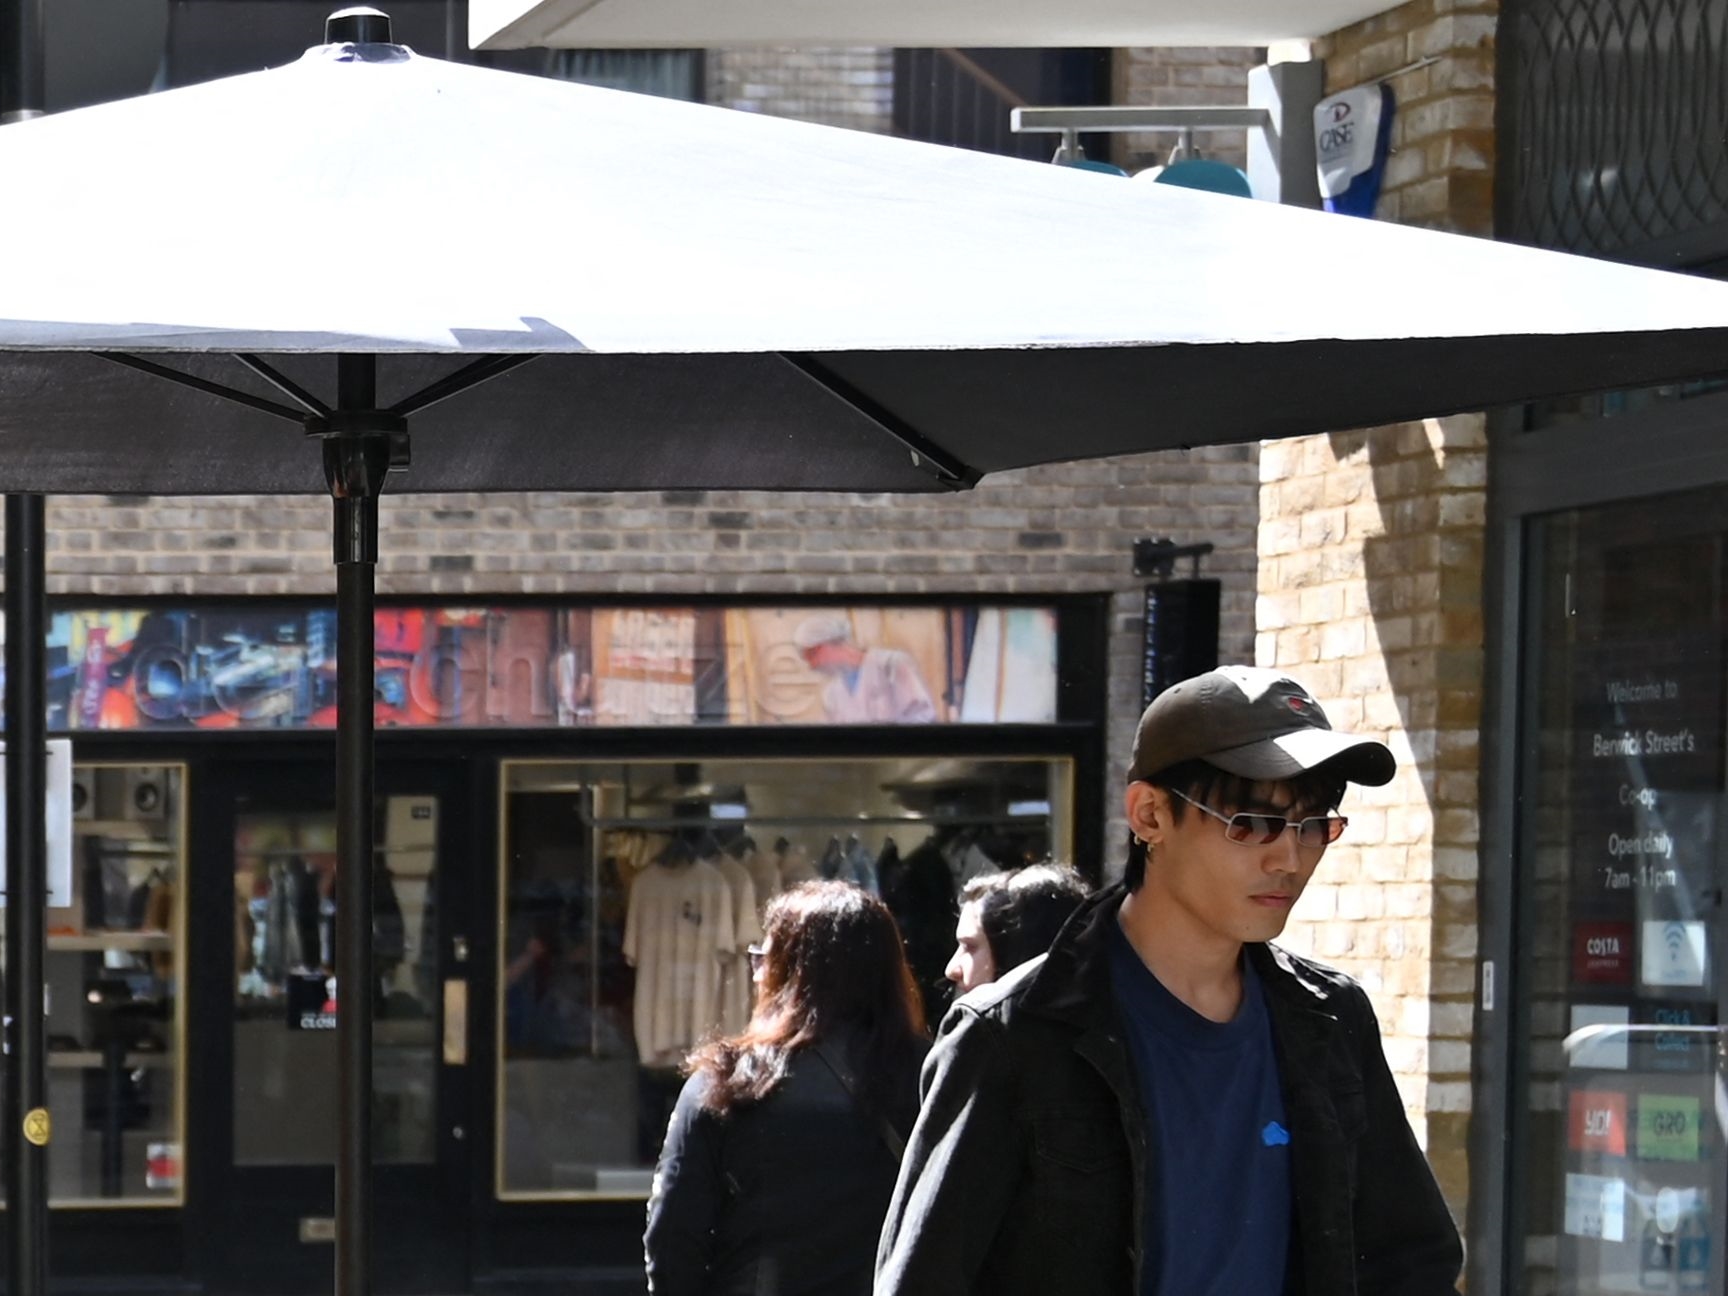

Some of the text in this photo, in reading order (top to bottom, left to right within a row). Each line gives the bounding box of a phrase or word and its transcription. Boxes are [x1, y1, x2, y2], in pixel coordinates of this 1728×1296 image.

[1606, 680, 1678, 703] Welcome to
[1593, 728, 1695, 757] Berwick Street's
[1619, 784, 1657, 811] Co-op
[1608, 830, 1673, 860] Open daily
[1604, 867, 1630, 889] 7am
[1640, 865, 1676, 892] 11pm
[1587, 937, 1619, 956] COSTA
